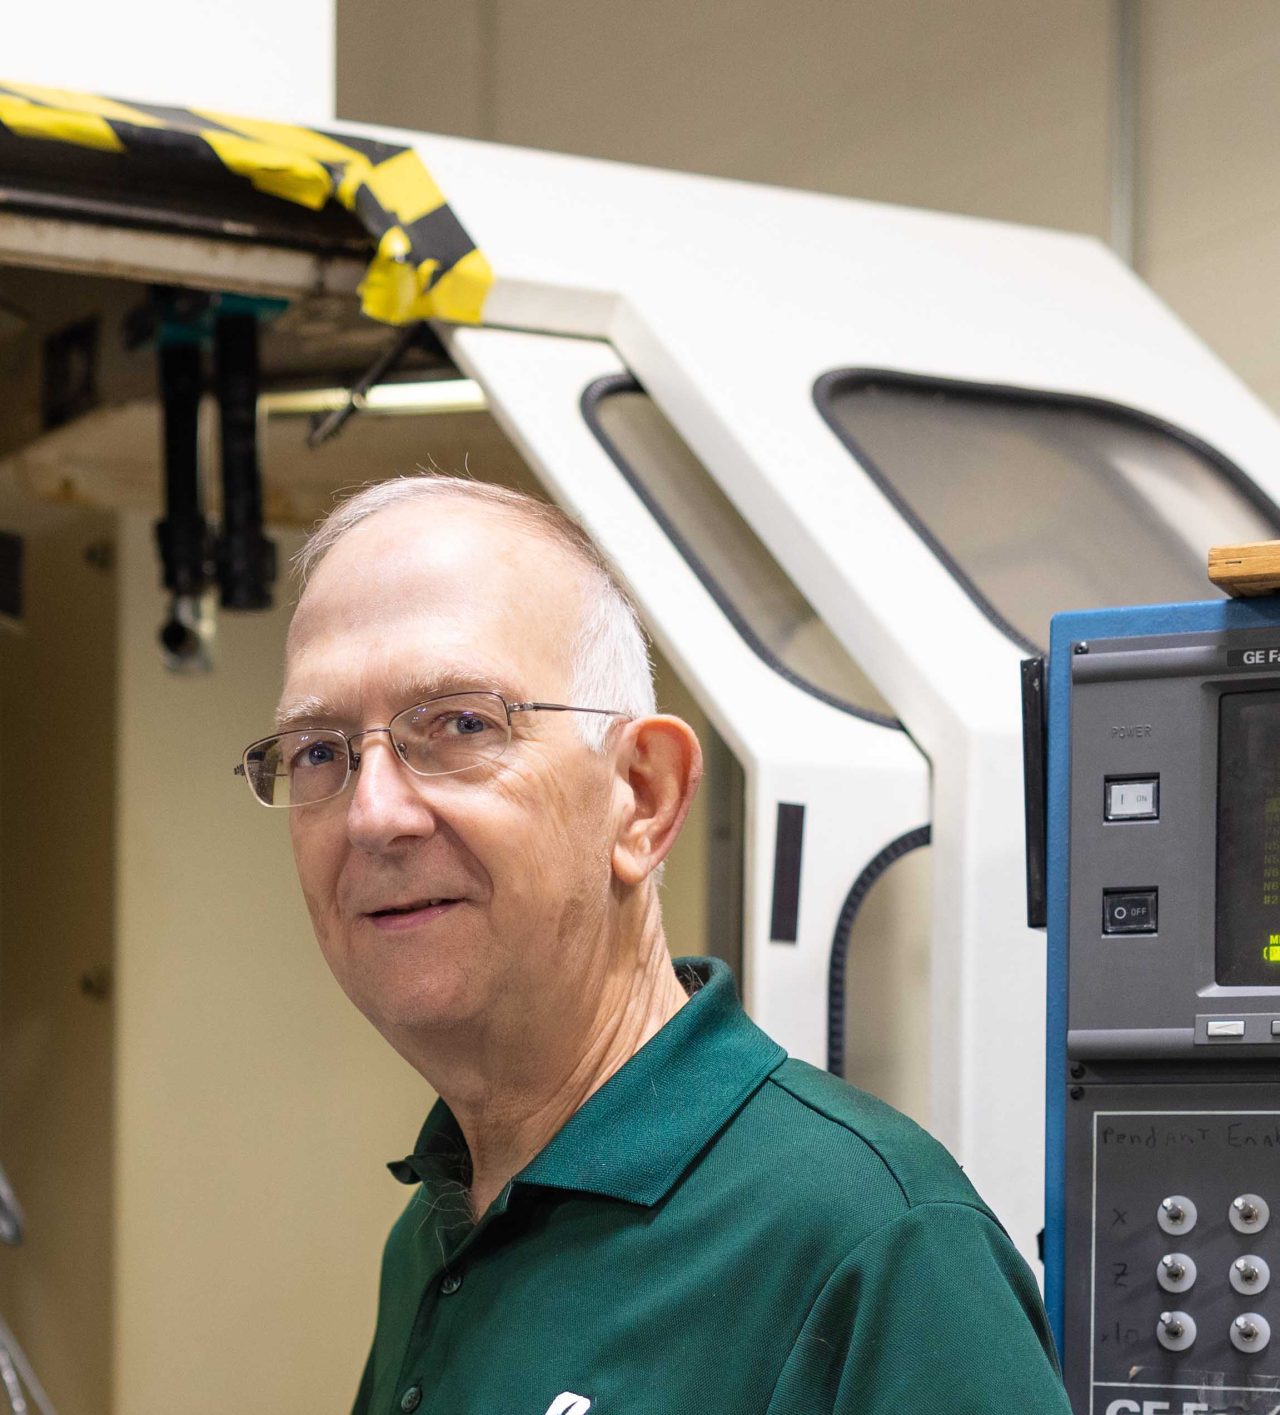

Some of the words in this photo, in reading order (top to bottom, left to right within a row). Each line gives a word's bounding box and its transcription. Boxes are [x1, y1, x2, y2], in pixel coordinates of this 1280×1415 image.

[1242, 650, 1265, 665] GE
[1111, 724, 1153, 739] POWER
[1136, 794, 1148, 803] ON
[1130, 907, 1148, 917] OFF
